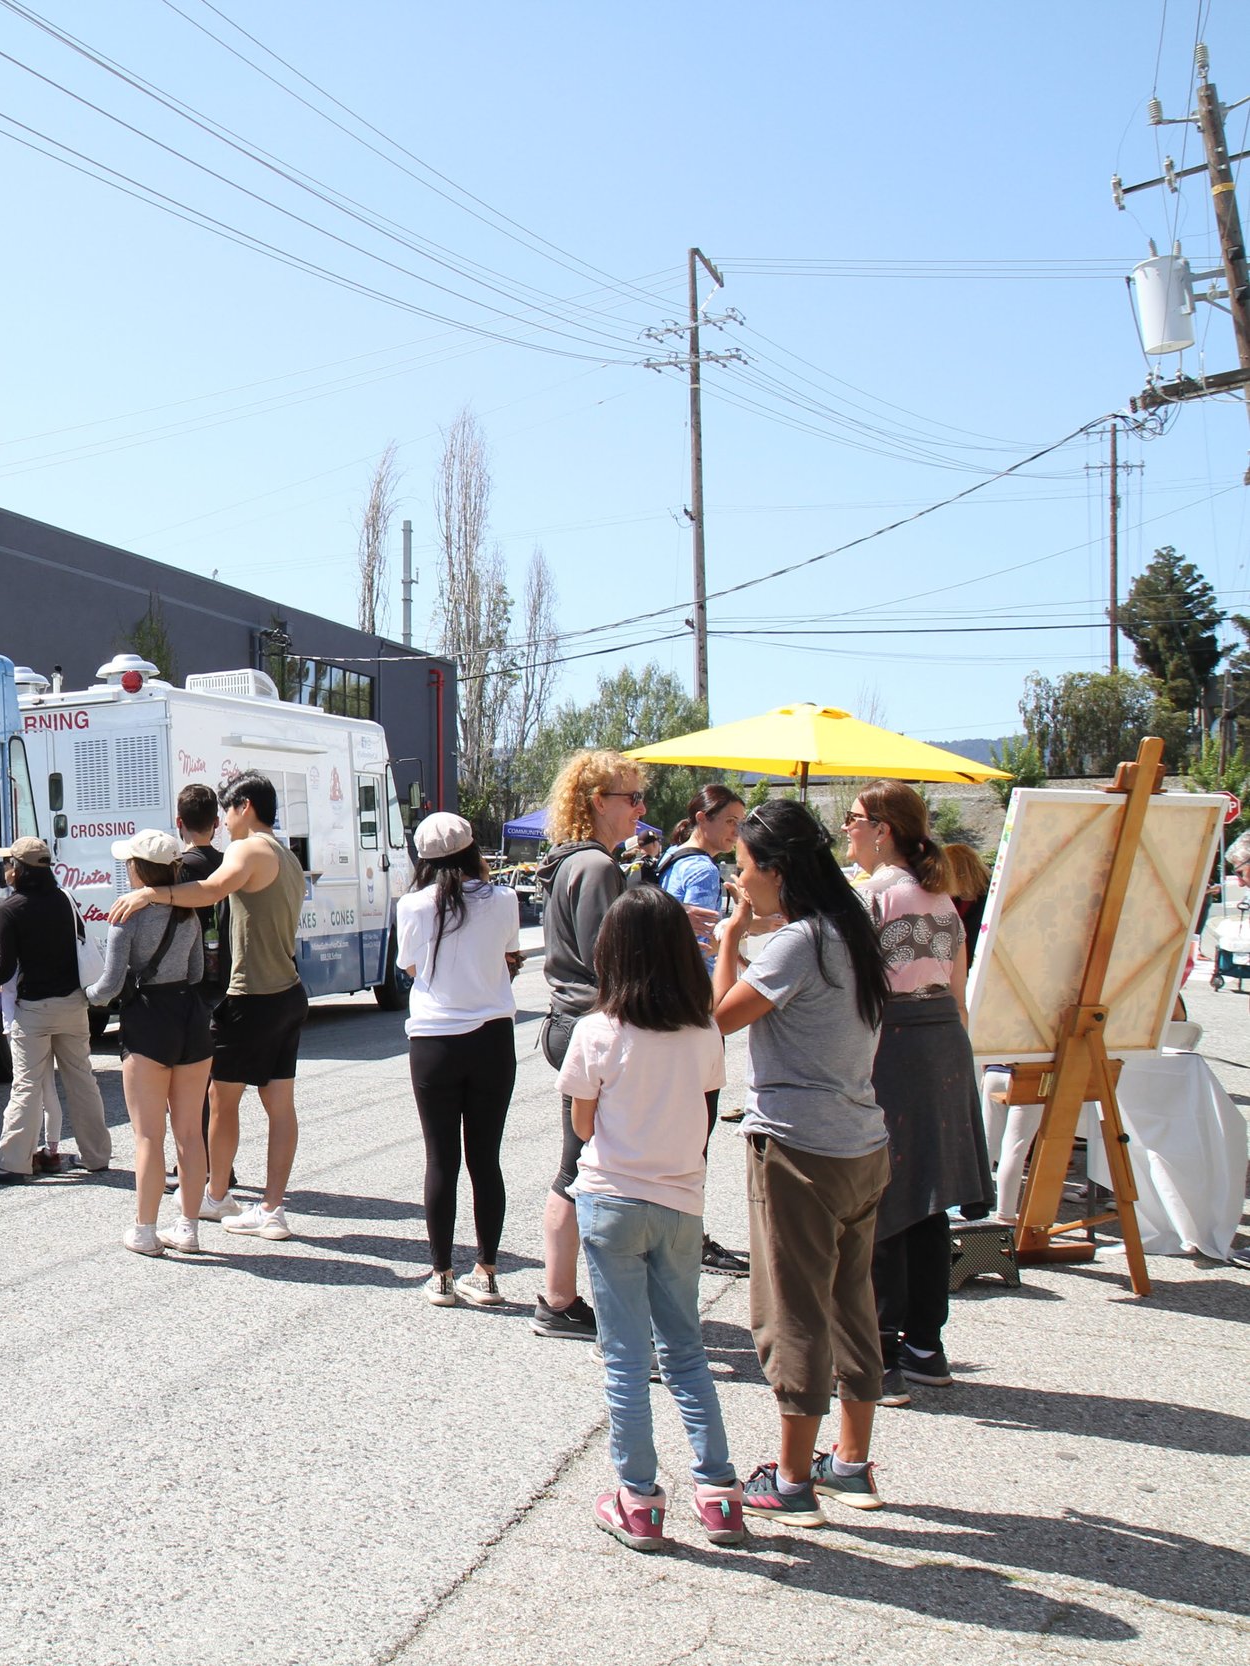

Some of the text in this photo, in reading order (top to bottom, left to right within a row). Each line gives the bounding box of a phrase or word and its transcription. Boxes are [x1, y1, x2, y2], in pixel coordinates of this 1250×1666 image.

[24, 711, 89, 734] RNING
[178, 749, 206, 777] Mister
[70, 821, 136, 838] CROSSING
[508, 827, 544, 836] COMMUNITY
[54, 863, 112, 890] Mister
[330, 910, 354, 926] CONES
